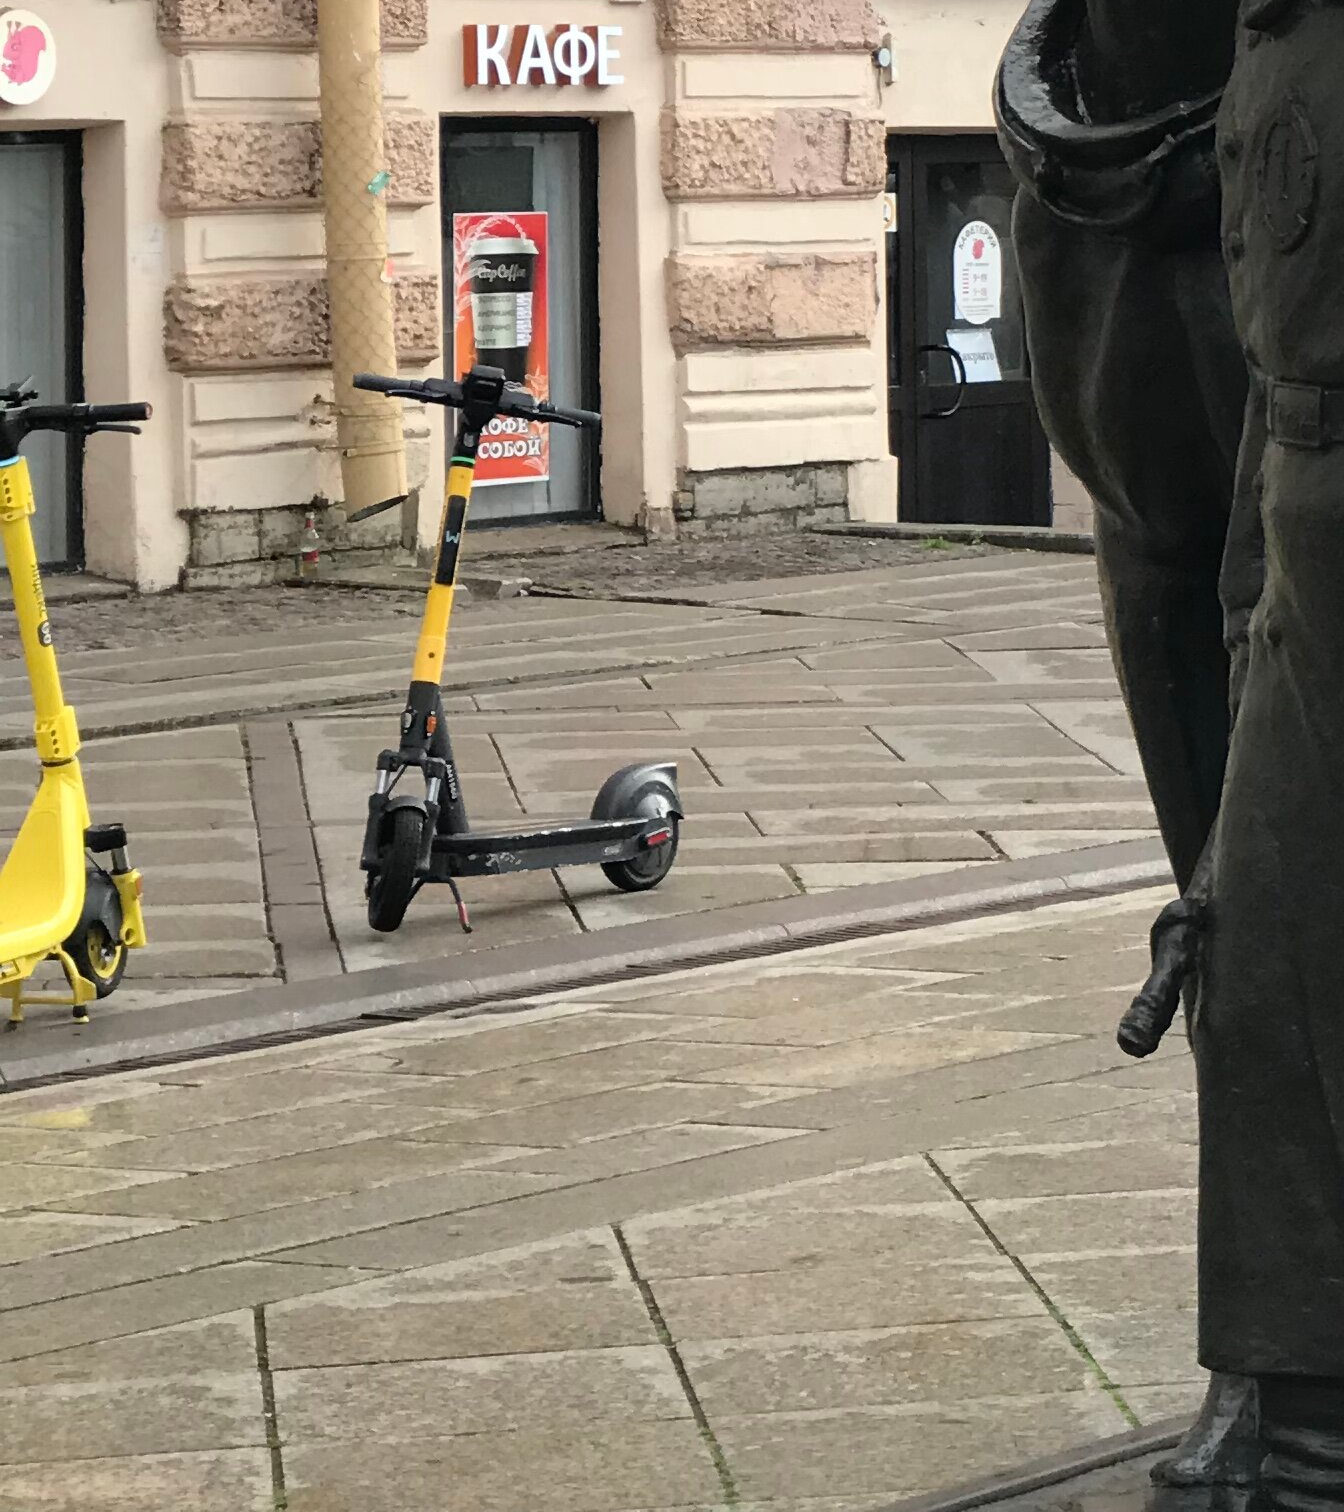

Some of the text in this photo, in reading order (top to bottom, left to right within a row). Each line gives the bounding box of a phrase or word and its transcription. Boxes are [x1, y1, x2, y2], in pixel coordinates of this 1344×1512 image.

[477, 24, 624, 85] КАФЕ
[962, 352, 995, 365] акрыто
[478, 436, 541, 460] СОБОЙ
